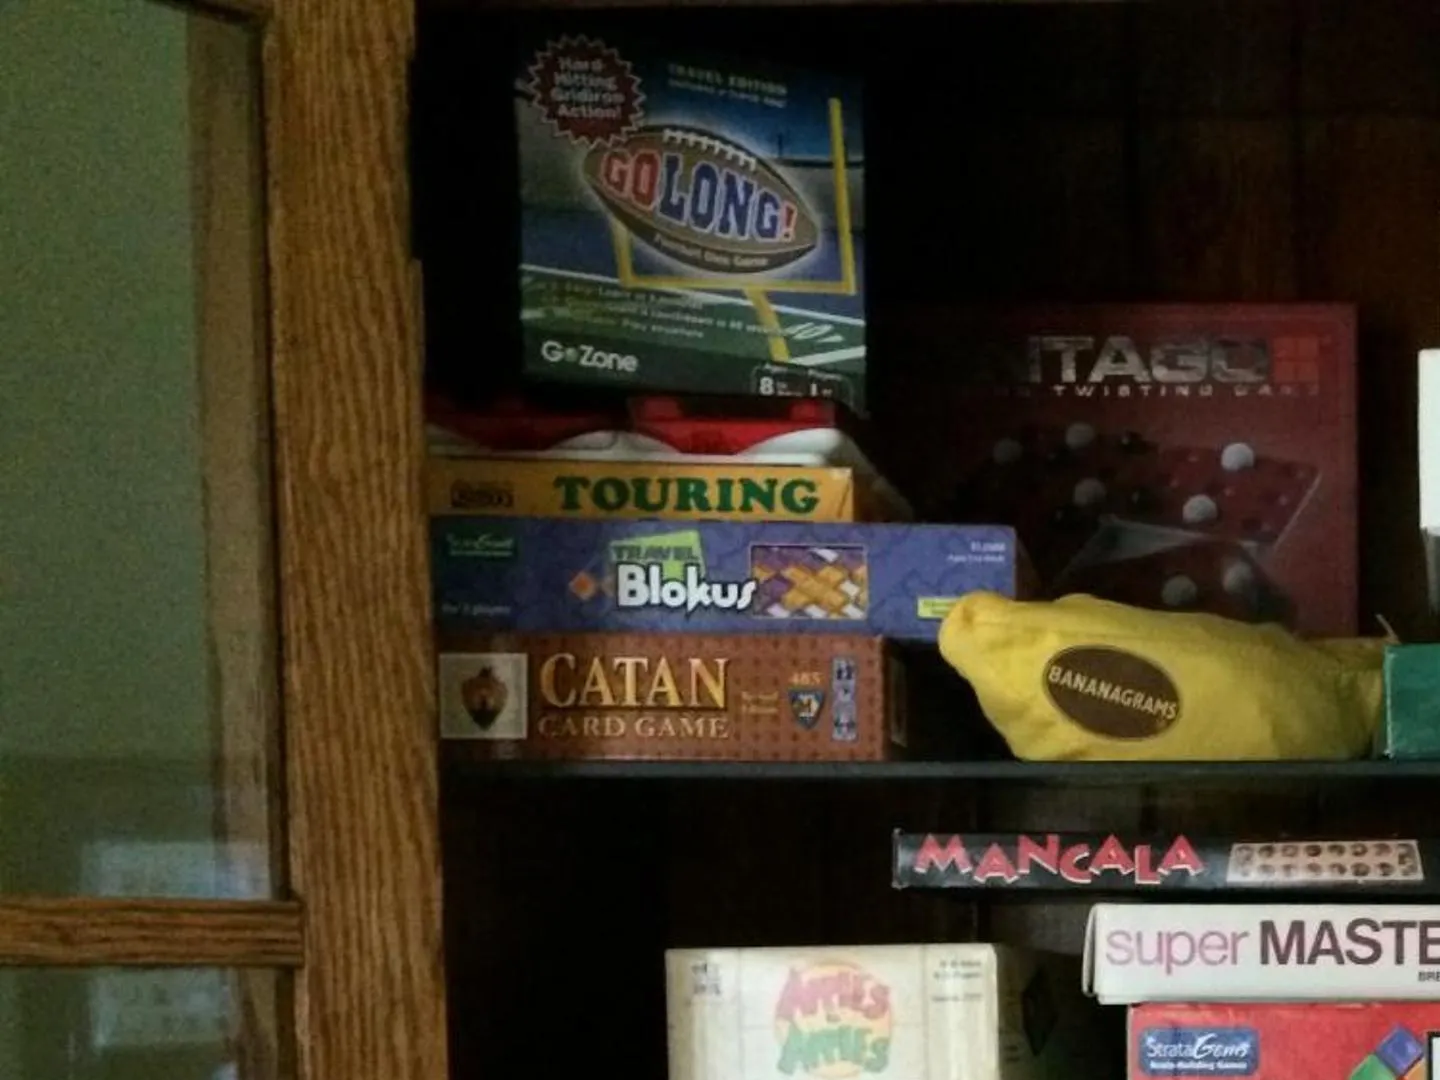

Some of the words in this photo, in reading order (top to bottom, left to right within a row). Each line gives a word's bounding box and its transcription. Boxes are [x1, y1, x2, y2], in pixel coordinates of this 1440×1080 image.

[601, 148, 661, 212] GO
[658, 152, 798, 244] LONG!
[552, 475, 820, 515] TOURING
[615, 559, 757, 613] Blokus
[537, 651, 731, 711] CATAN
[1047, 664, 1179, 721] BANANAGRAMS
[537, 714, 627, 739] CARD
[630, 713, 730, 740] GAME
[912, 831, 1203, 886] MANCALA
[1105, 927, 1250, 975] super
